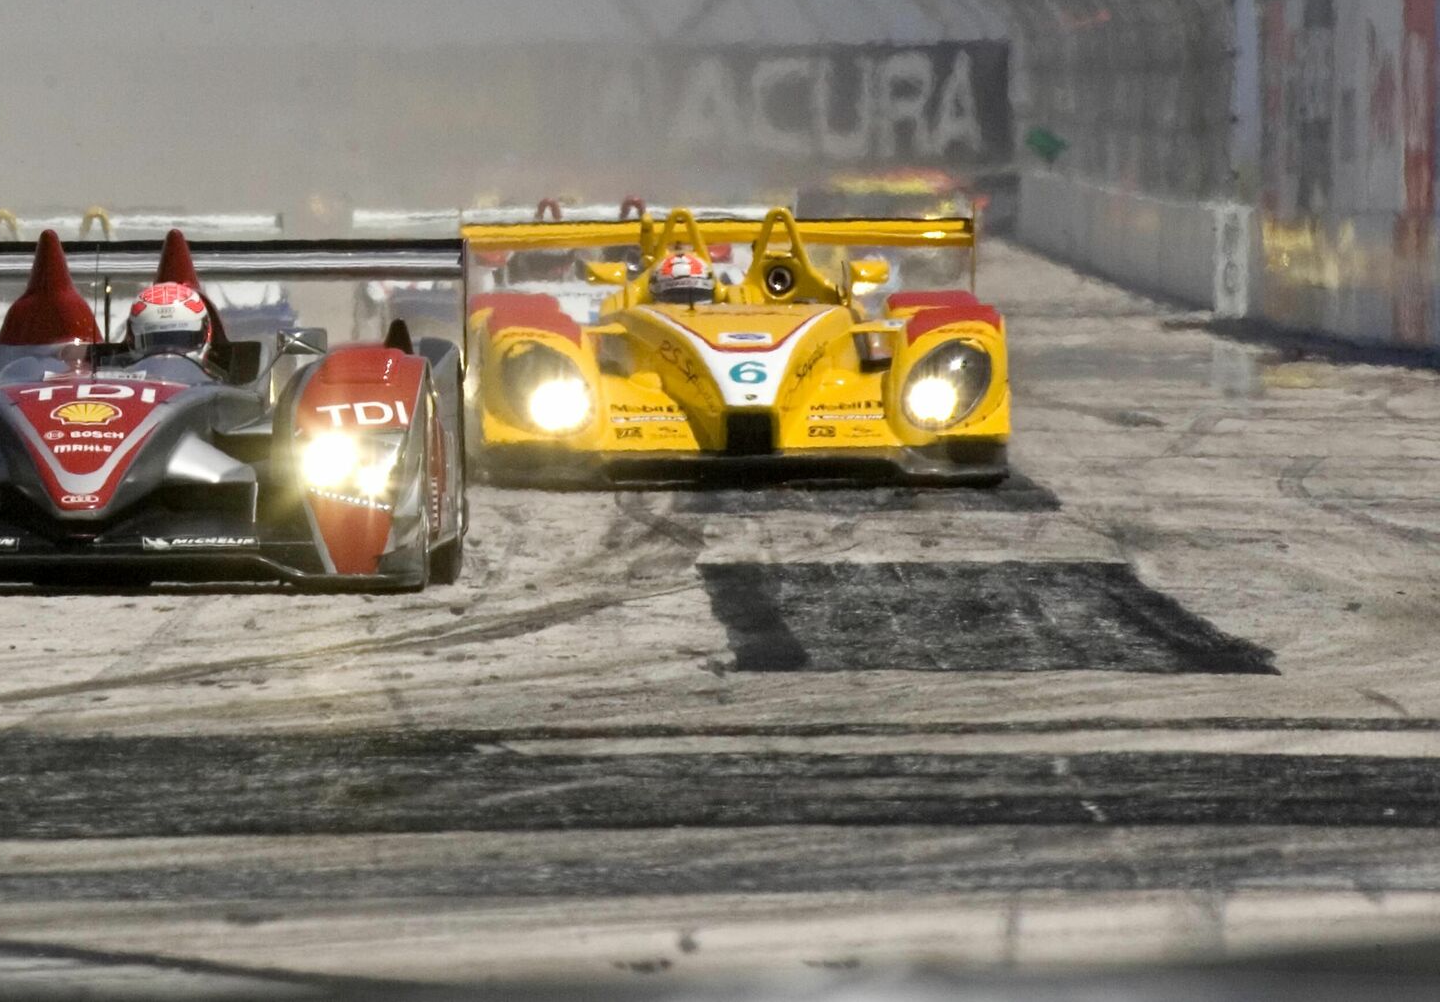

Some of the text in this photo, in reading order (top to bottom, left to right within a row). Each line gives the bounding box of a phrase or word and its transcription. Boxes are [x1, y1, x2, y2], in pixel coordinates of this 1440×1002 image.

[667, 49, 981, 158] ACURA
[728, 360, 768, 384] 6
[20, 384, 157, 404] TDI
[315, 400, 410, 427] TDI
[69, 430, 125, 440] BOSCH
[53, 444, 113, 454] MAHLE
[171, 537, 256, 545] MICHELIN
